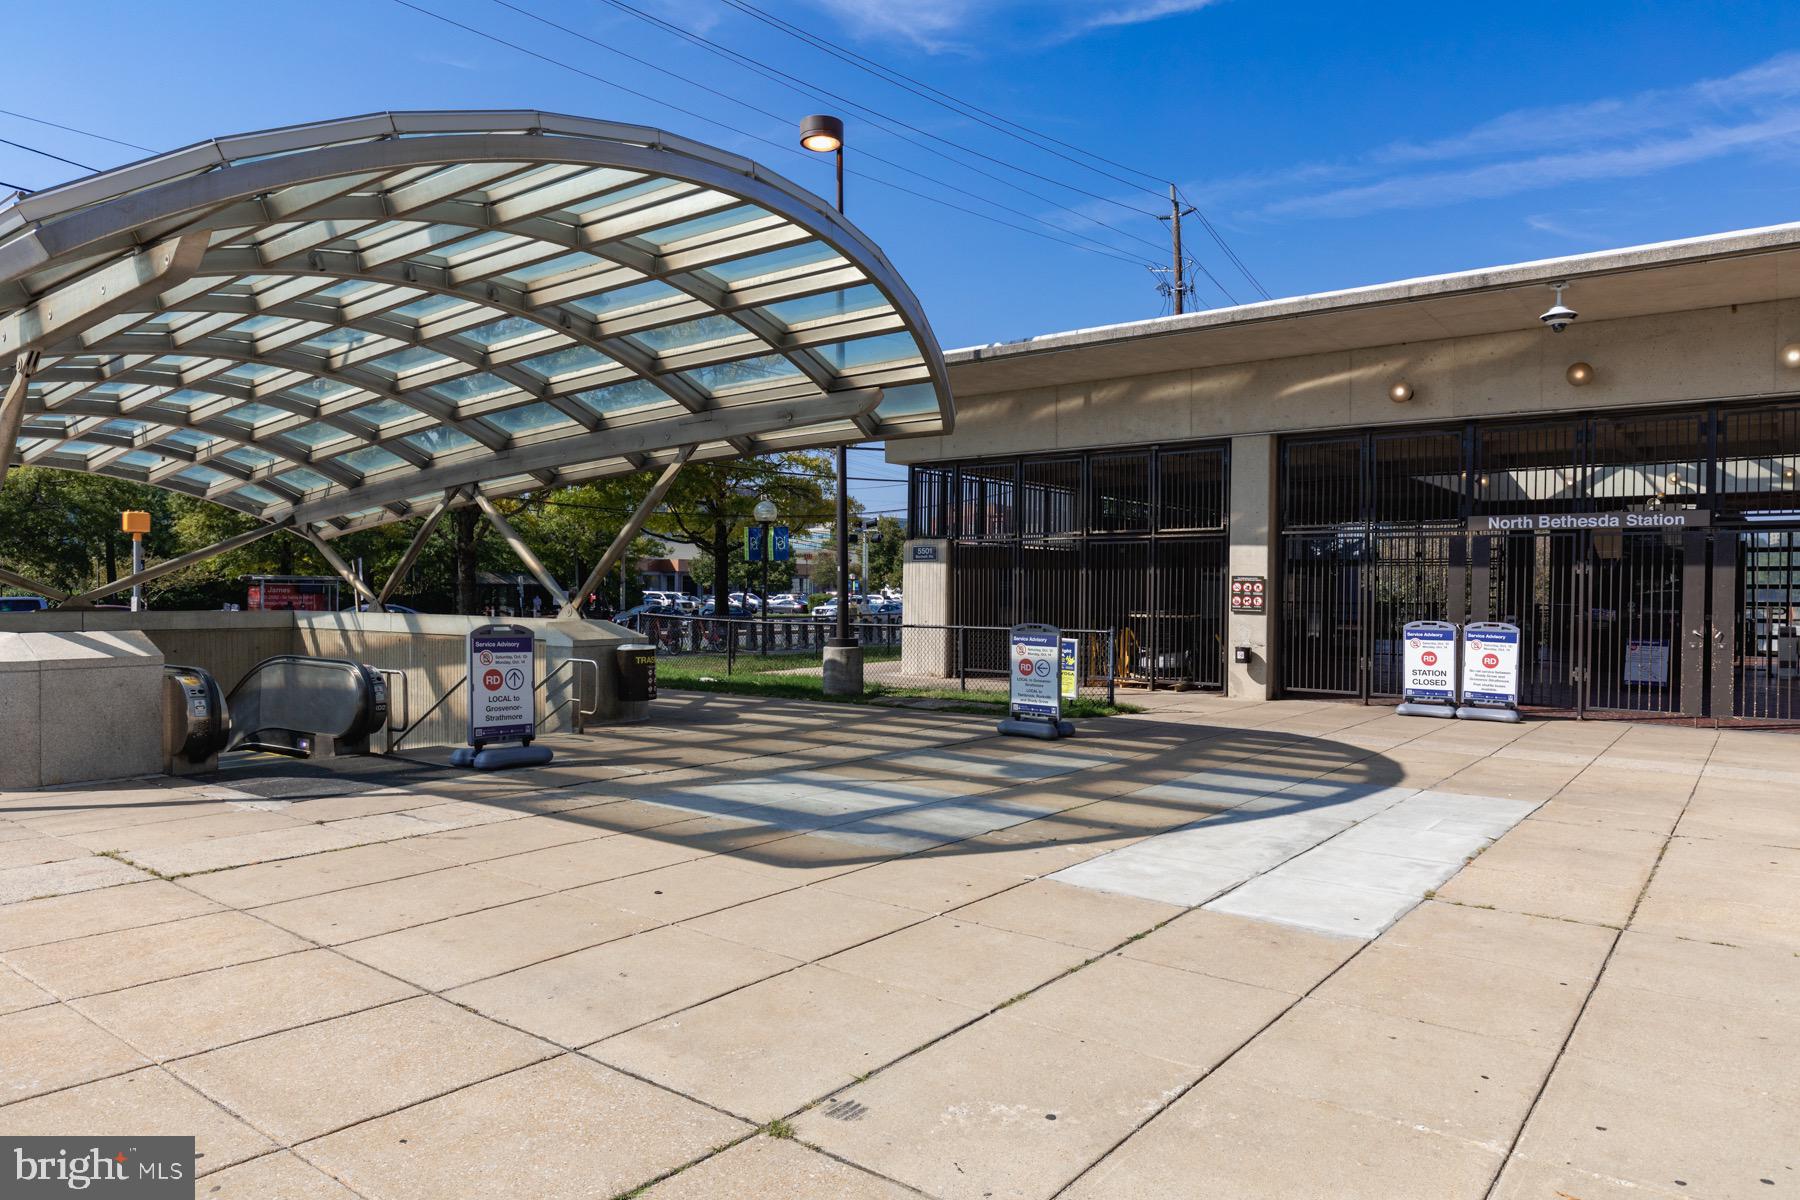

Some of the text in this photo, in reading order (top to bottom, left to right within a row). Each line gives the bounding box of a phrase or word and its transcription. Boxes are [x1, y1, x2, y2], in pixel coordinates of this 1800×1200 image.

[1488, 514, 1684, 530] North Bethesda Station
[636, 656, 656, 664] TRAS
[486, 675, 500, 685] RD
